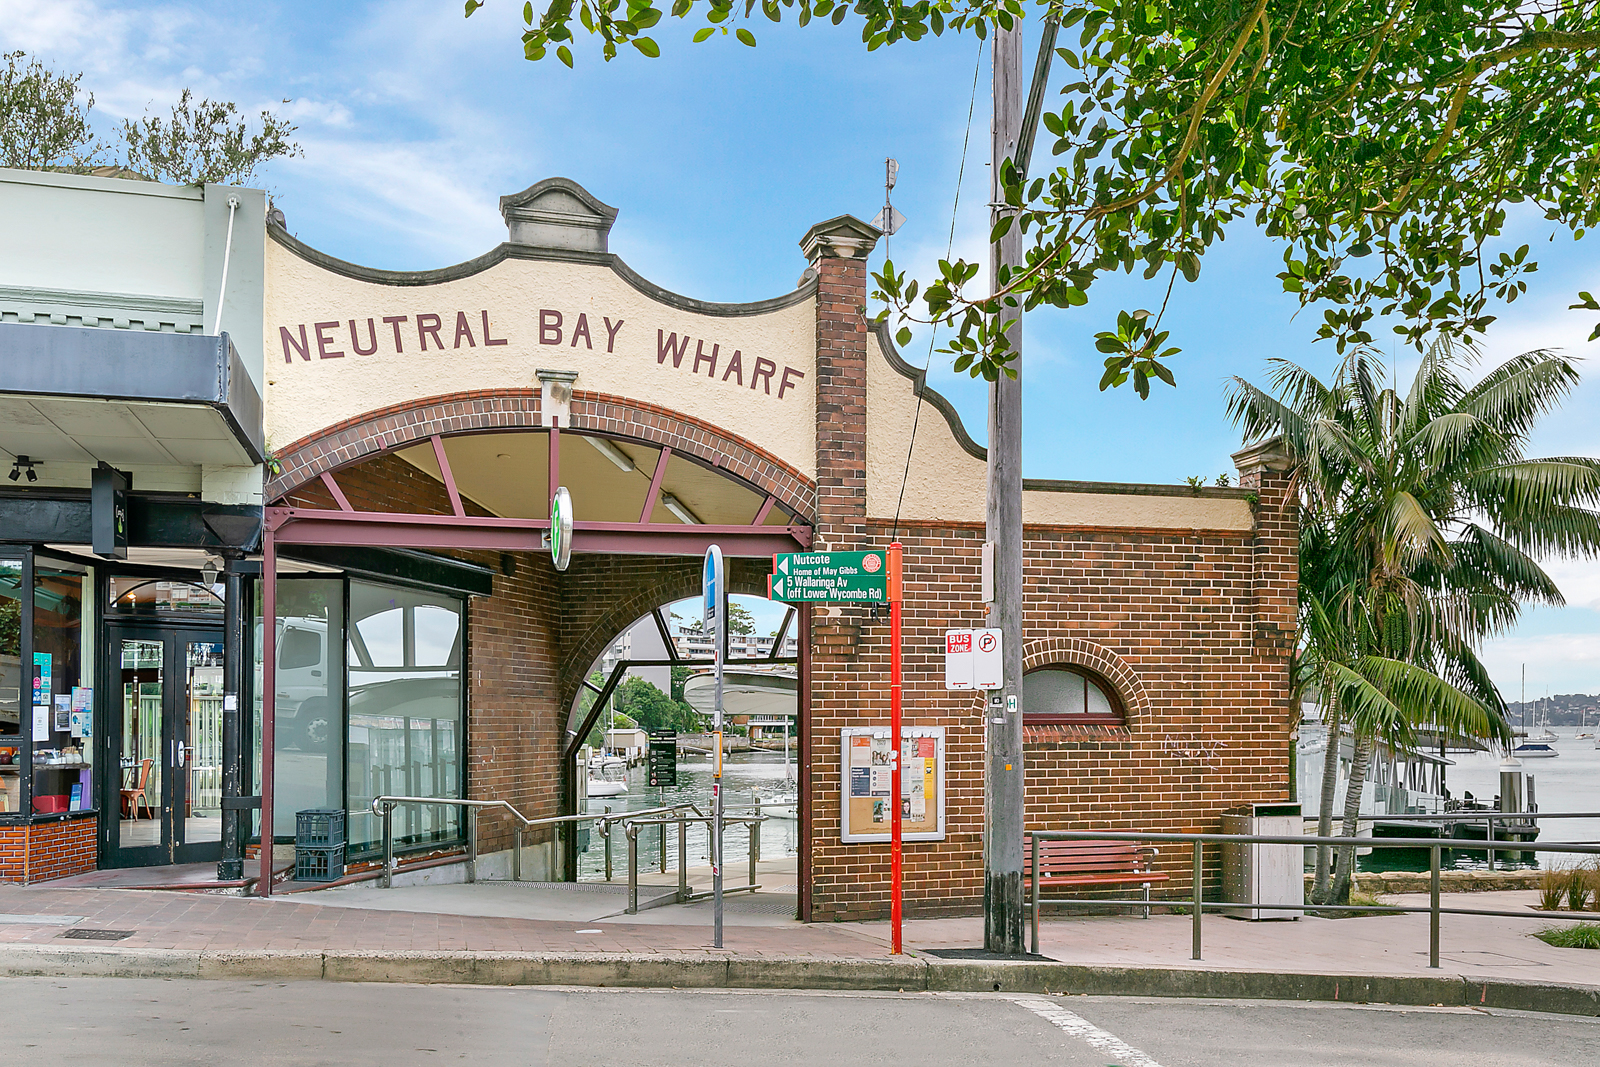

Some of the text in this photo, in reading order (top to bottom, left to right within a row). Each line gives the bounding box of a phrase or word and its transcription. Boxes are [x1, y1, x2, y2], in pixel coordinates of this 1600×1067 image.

[278, 308, 806, 400] NEUTRAL BAY WHARF
[793, 554, 830, 565] Nutcote
[793, 566, 858, 576] Home of May Gibbs
[787, 576, 848, 589] 5 Wallaringa Av
[787, 588, 882, 601] (off Lower Wycombe Rd)
[949, 635, 970, 644] BUS
[950, 644, 969, 653] ZONE
[1008, 699, 1016, 709] H
